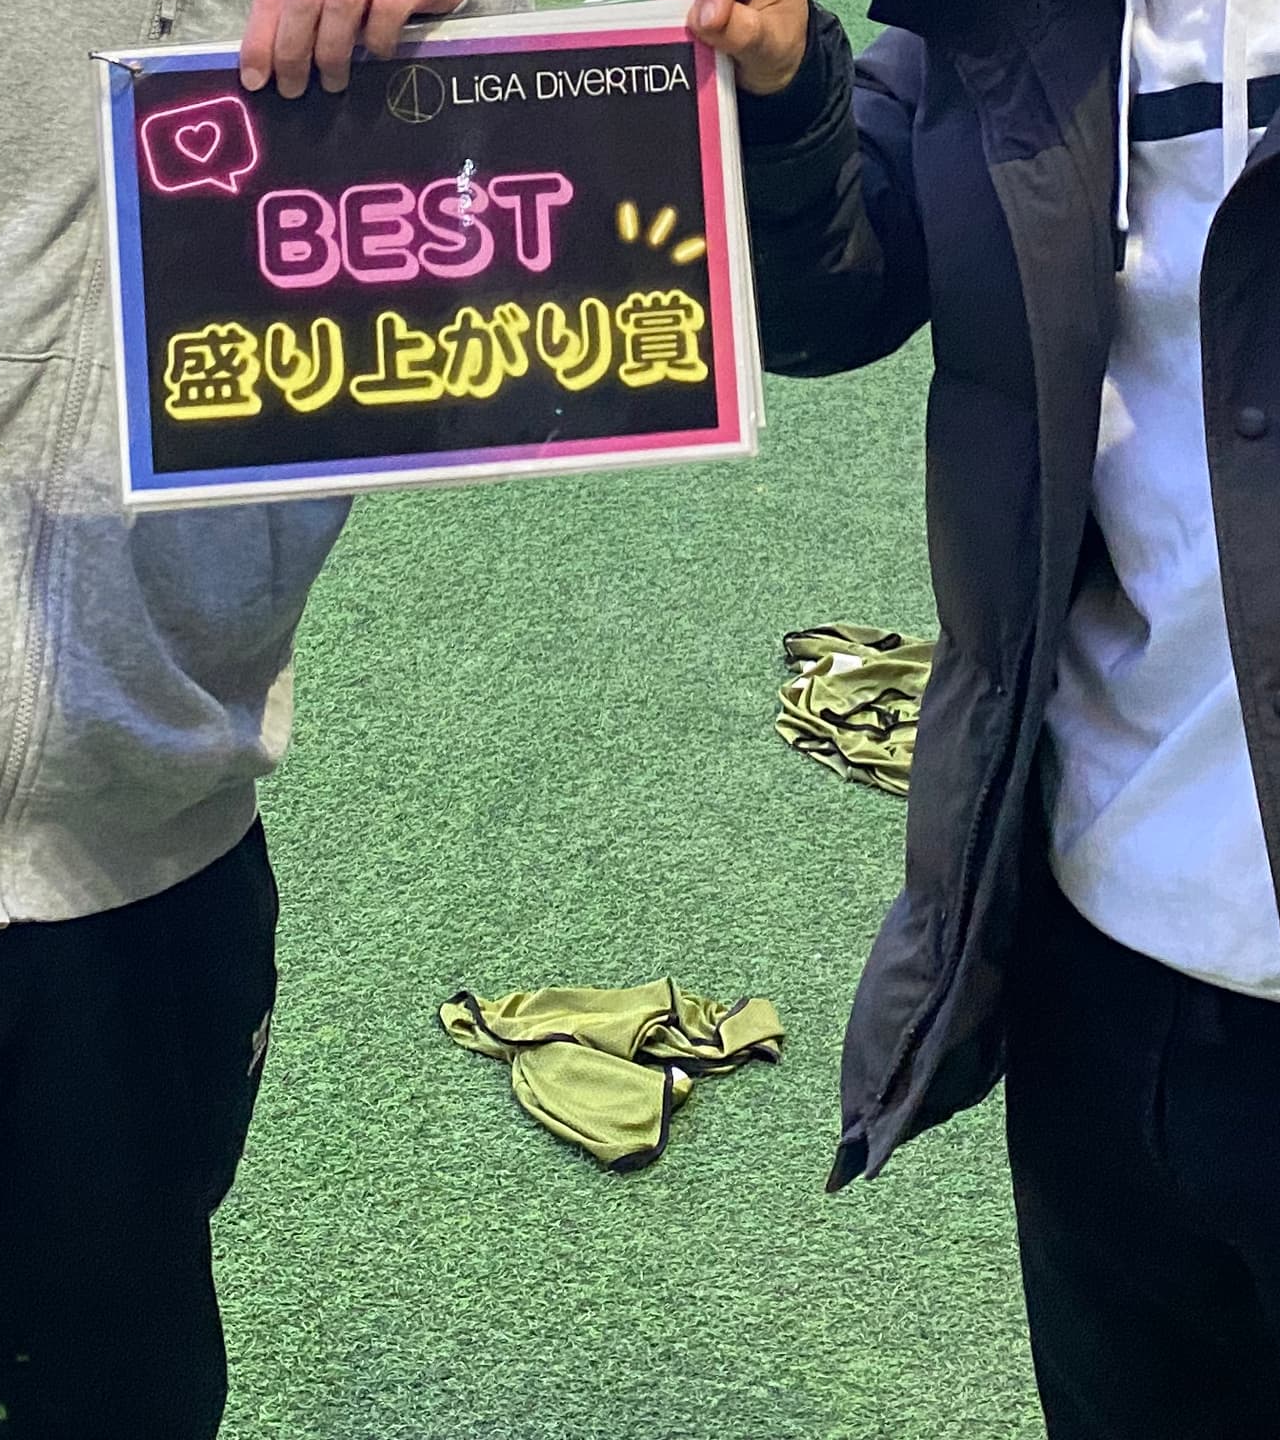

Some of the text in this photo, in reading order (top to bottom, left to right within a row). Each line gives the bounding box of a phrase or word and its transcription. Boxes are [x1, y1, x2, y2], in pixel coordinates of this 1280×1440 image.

[257, 171, 574, 290] BEST
[164, 288, 708, 421] 盛り上がり賞
